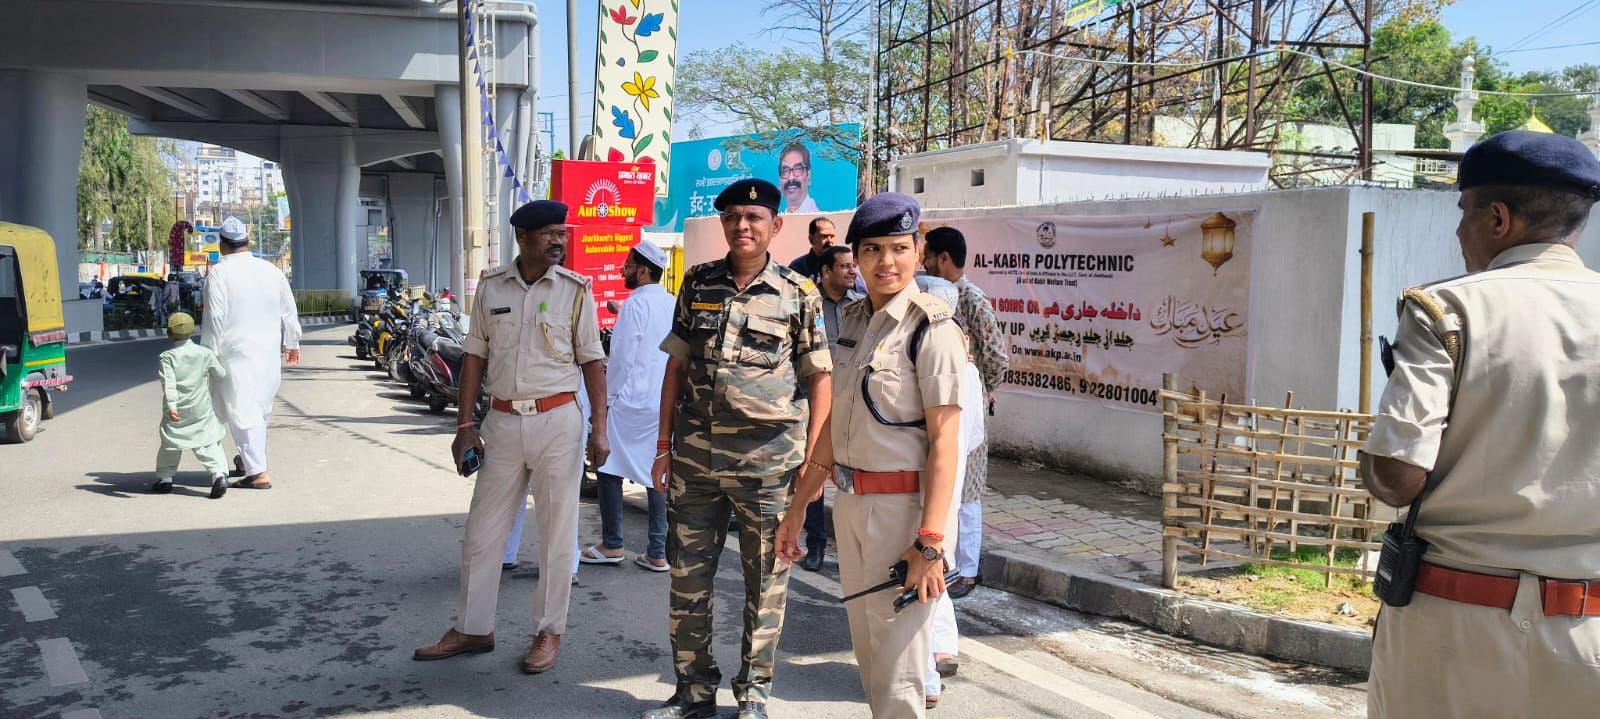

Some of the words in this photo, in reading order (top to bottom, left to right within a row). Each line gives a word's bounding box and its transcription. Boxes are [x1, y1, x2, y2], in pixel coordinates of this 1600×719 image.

[614, 233, 634, 243] Biggest
[585, 245, 614, 254] Automobile
[973, 253, 1030, 269] AL-KABIR
[1035, 254, 1134, 272] POLYTECHNIC
[998, 298, 1024, 313] GOING
[1010, 322, 1025, 336] UP
[1012, 344, 1022, 355] On
